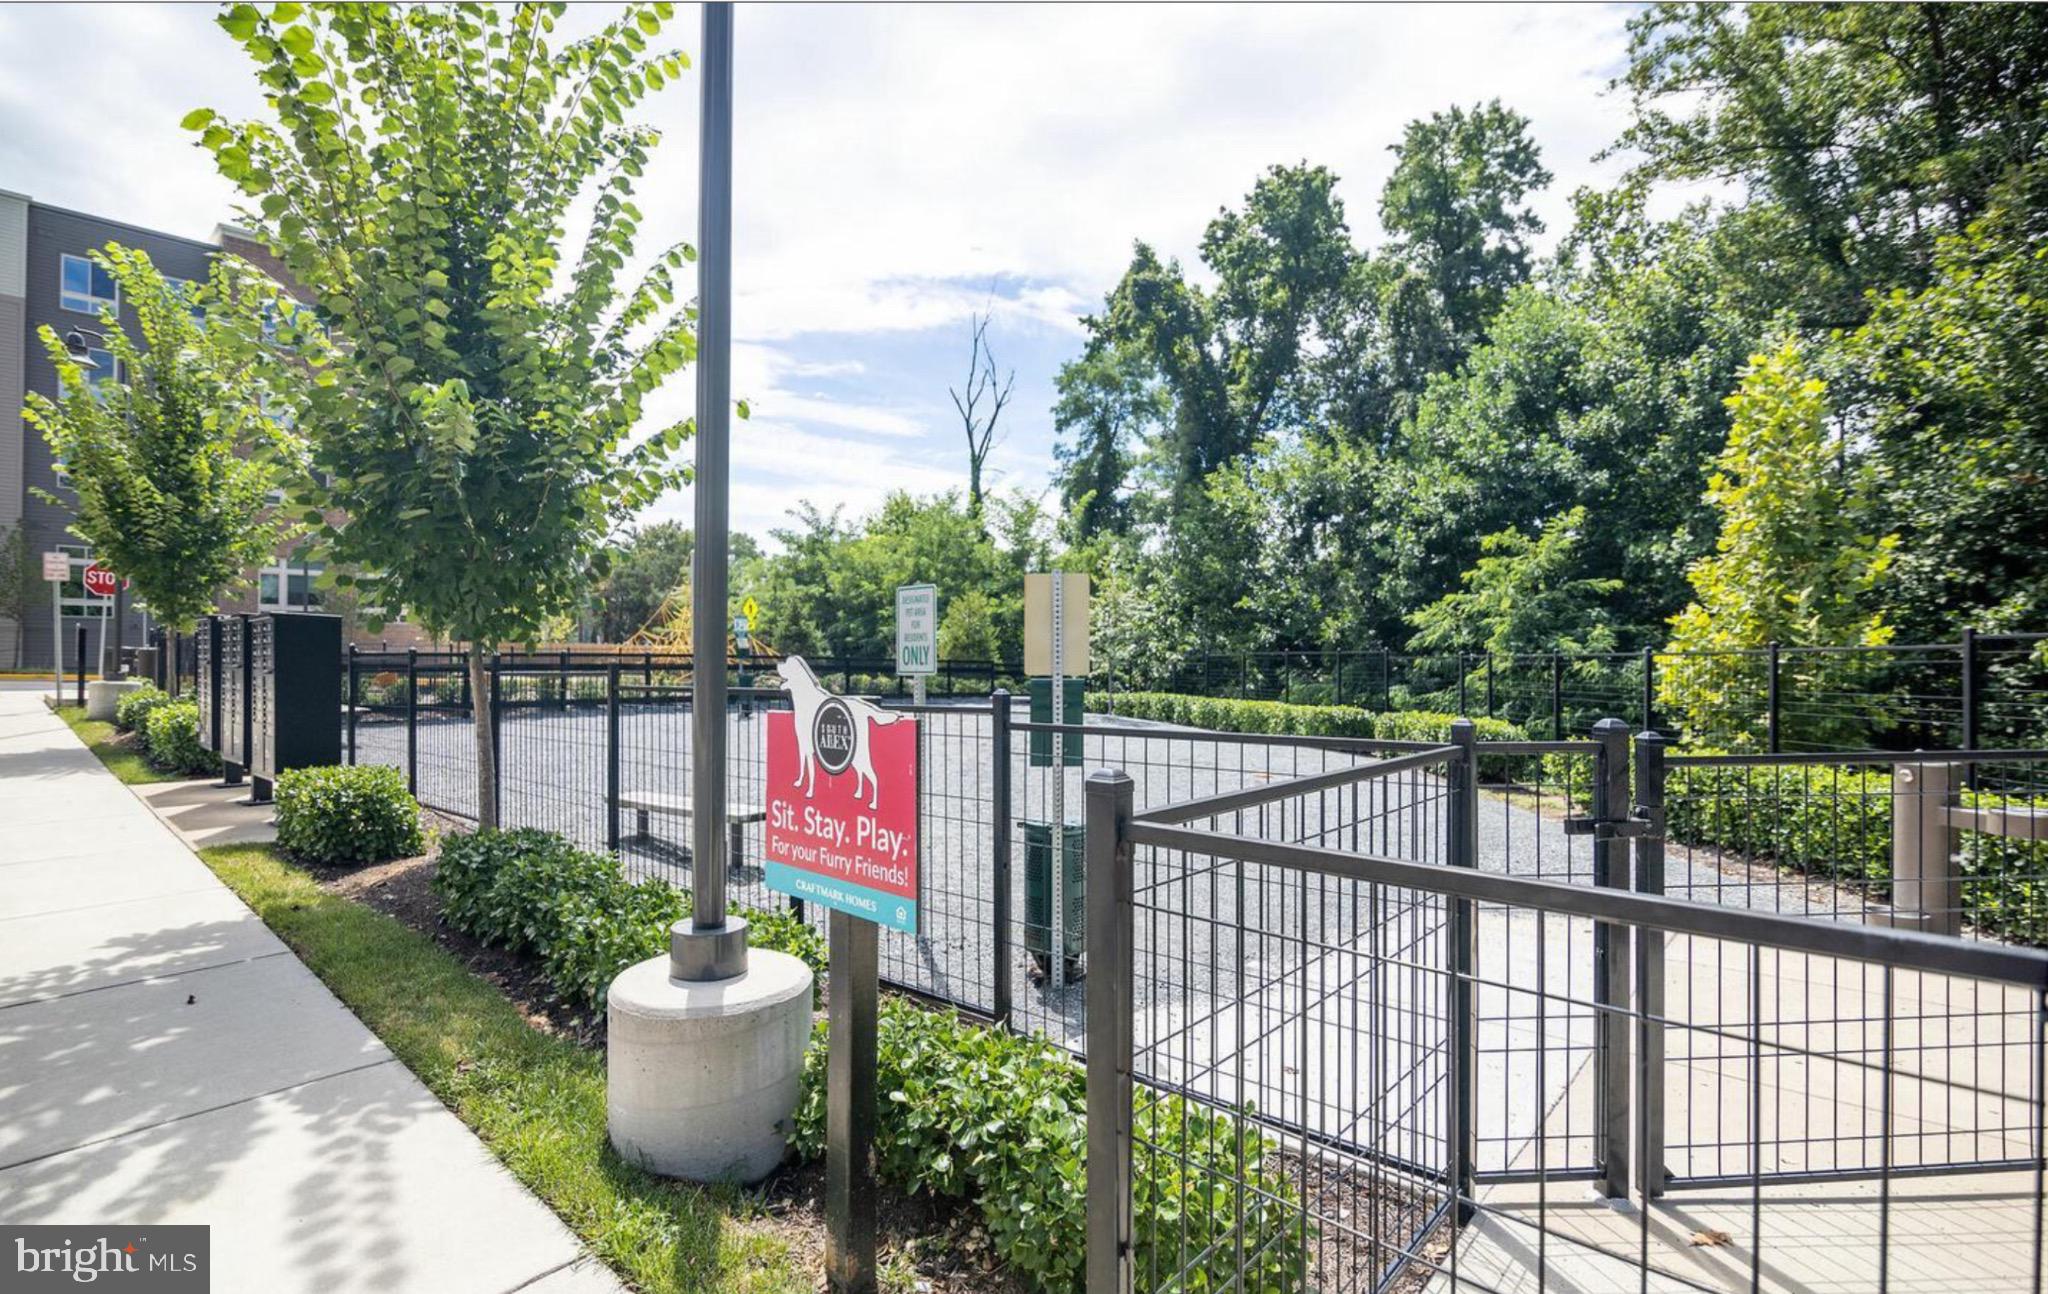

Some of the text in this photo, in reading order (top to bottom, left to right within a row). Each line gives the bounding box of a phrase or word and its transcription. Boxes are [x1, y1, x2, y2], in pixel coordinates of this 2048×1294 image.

[87, 570, 116, 585] STO
[902, 645, 930, 666] ONLY
[819, 734, 849, 751] ALEX
[771, 799, 908, 861] Sit. Stay. Play.
[771, 835, 909, 887] For your Furry Friends!
[796, 879, 878, 913] CRAFTMARK HOMES
